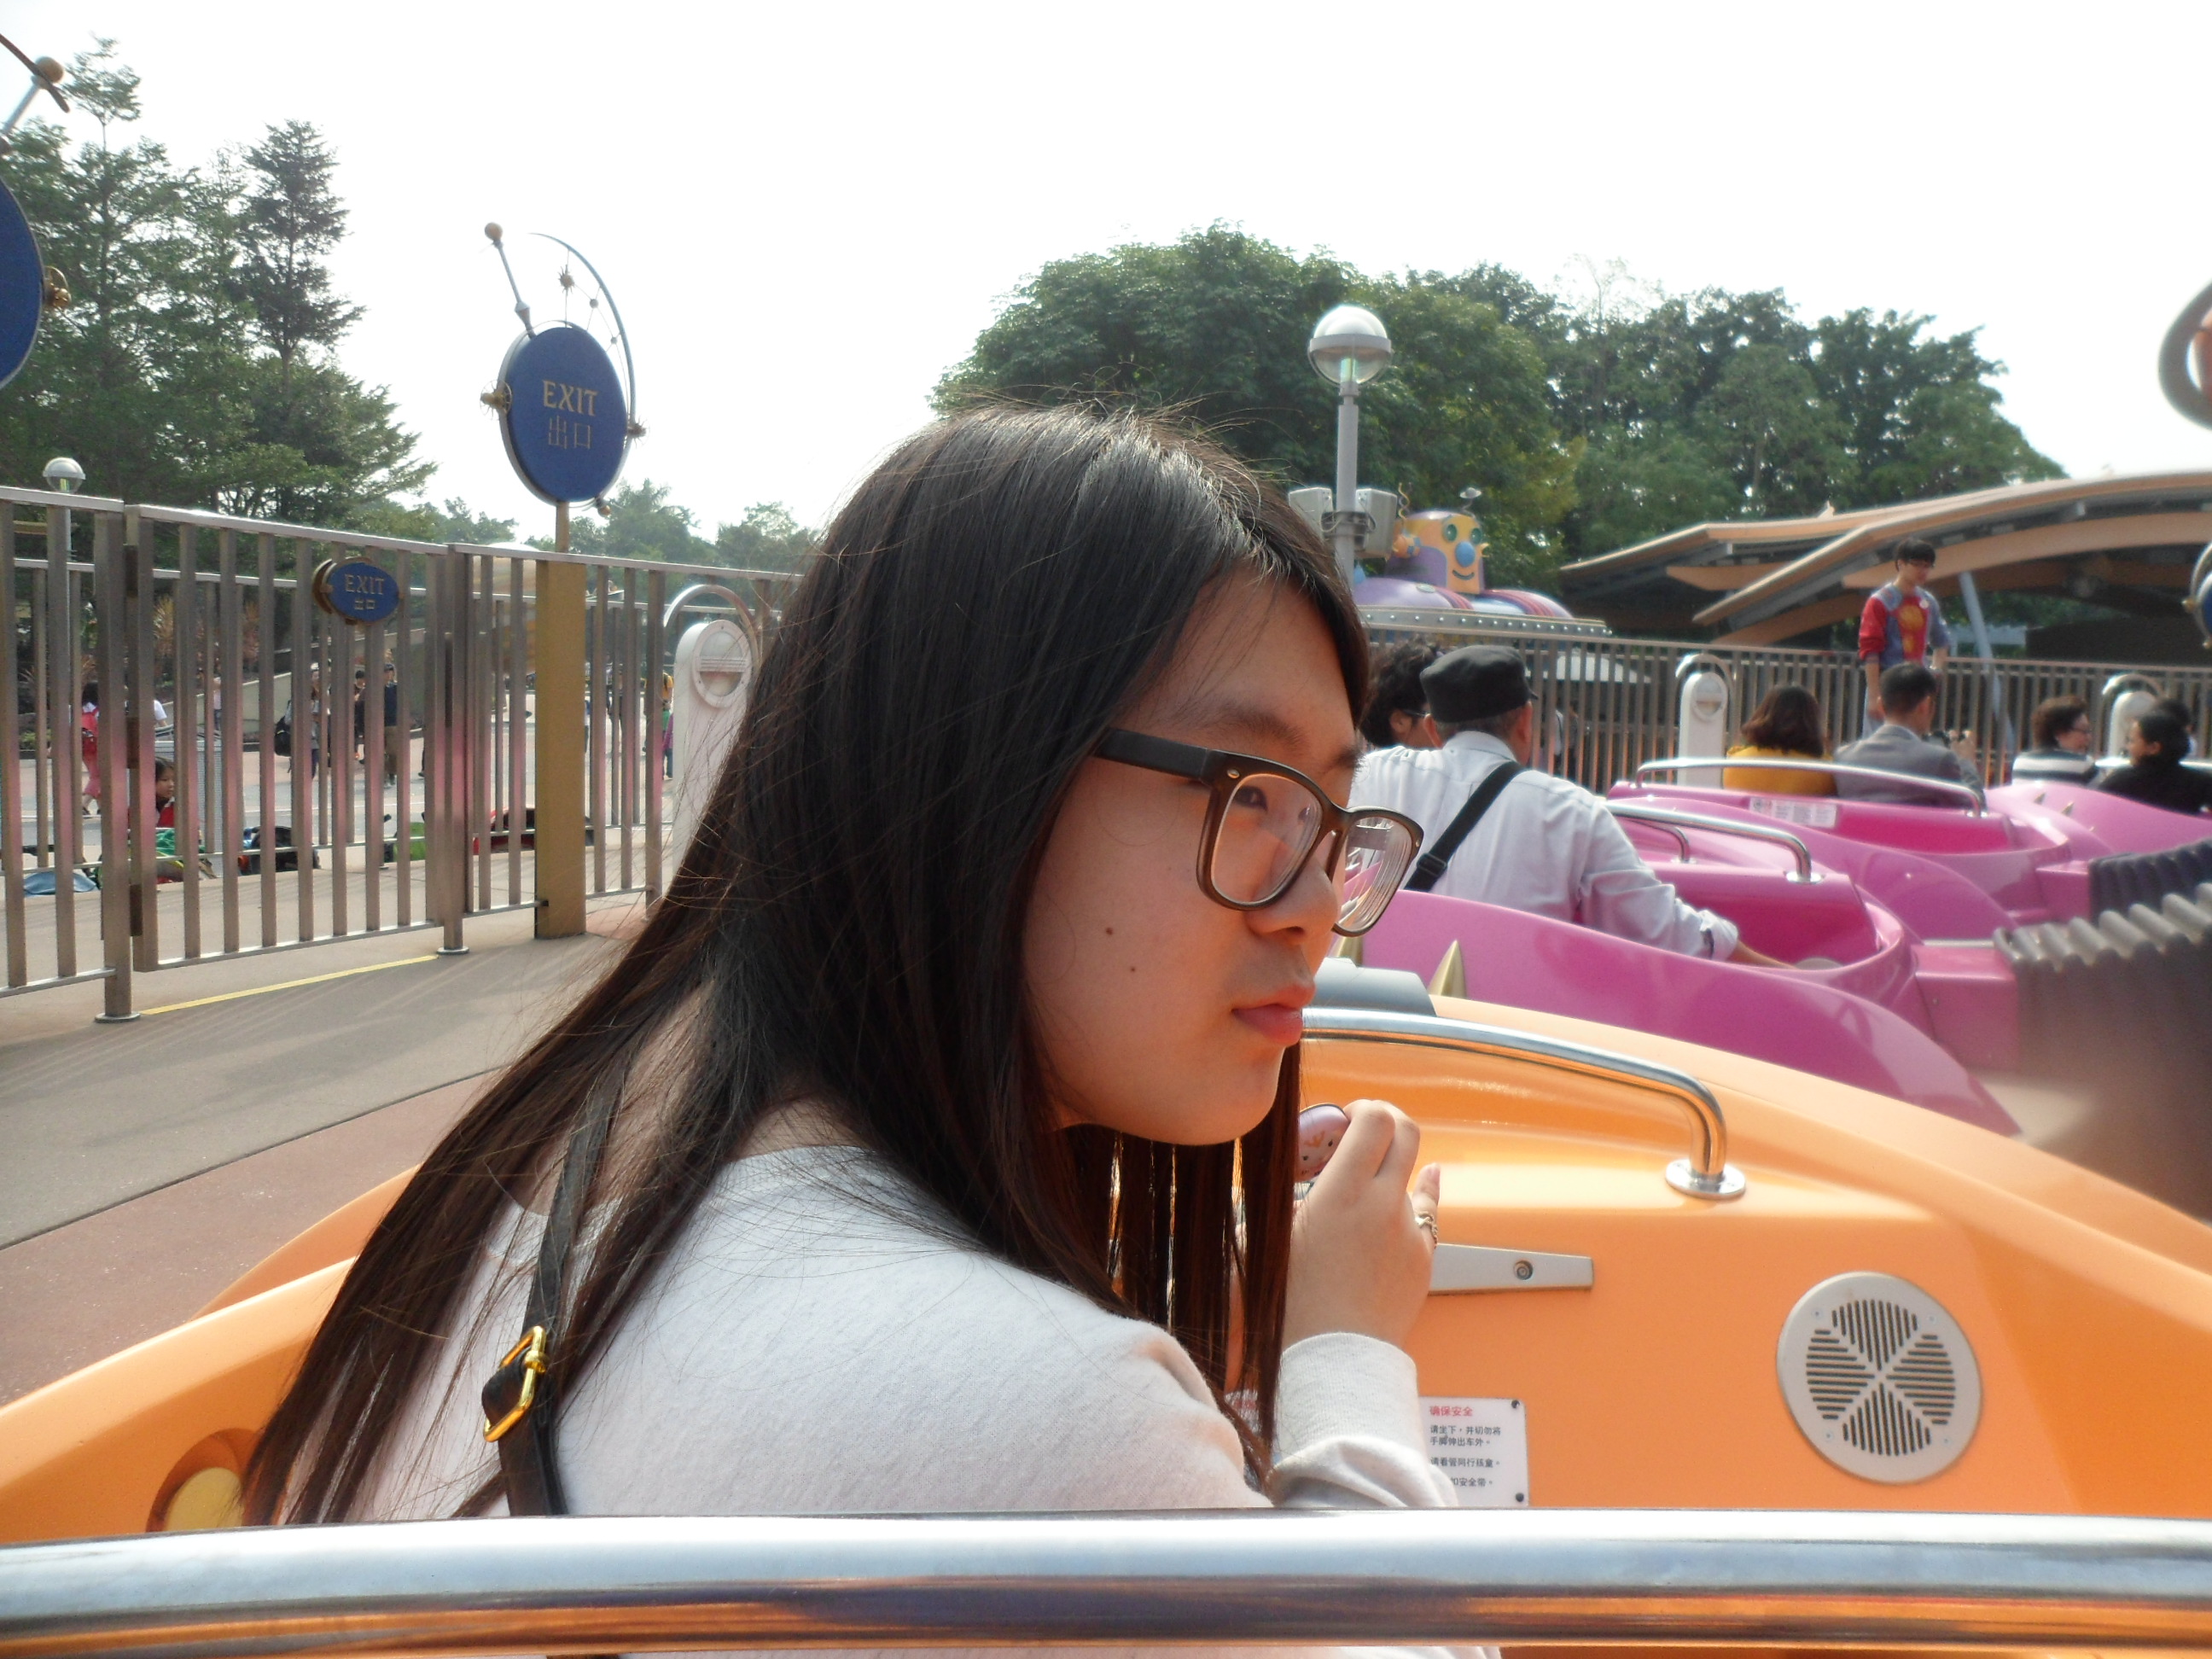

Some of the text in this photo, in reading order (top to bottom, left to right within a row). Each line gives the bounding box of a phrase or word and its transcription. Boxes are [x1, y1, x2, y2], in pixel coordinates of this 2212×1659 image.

[542, 380, 598, 416] EXIT
[548, 415, 591, 449] 出口
[345, 573, 384, 595] EXIT
[1429, 1406, 1473, 1417] 确保安全
